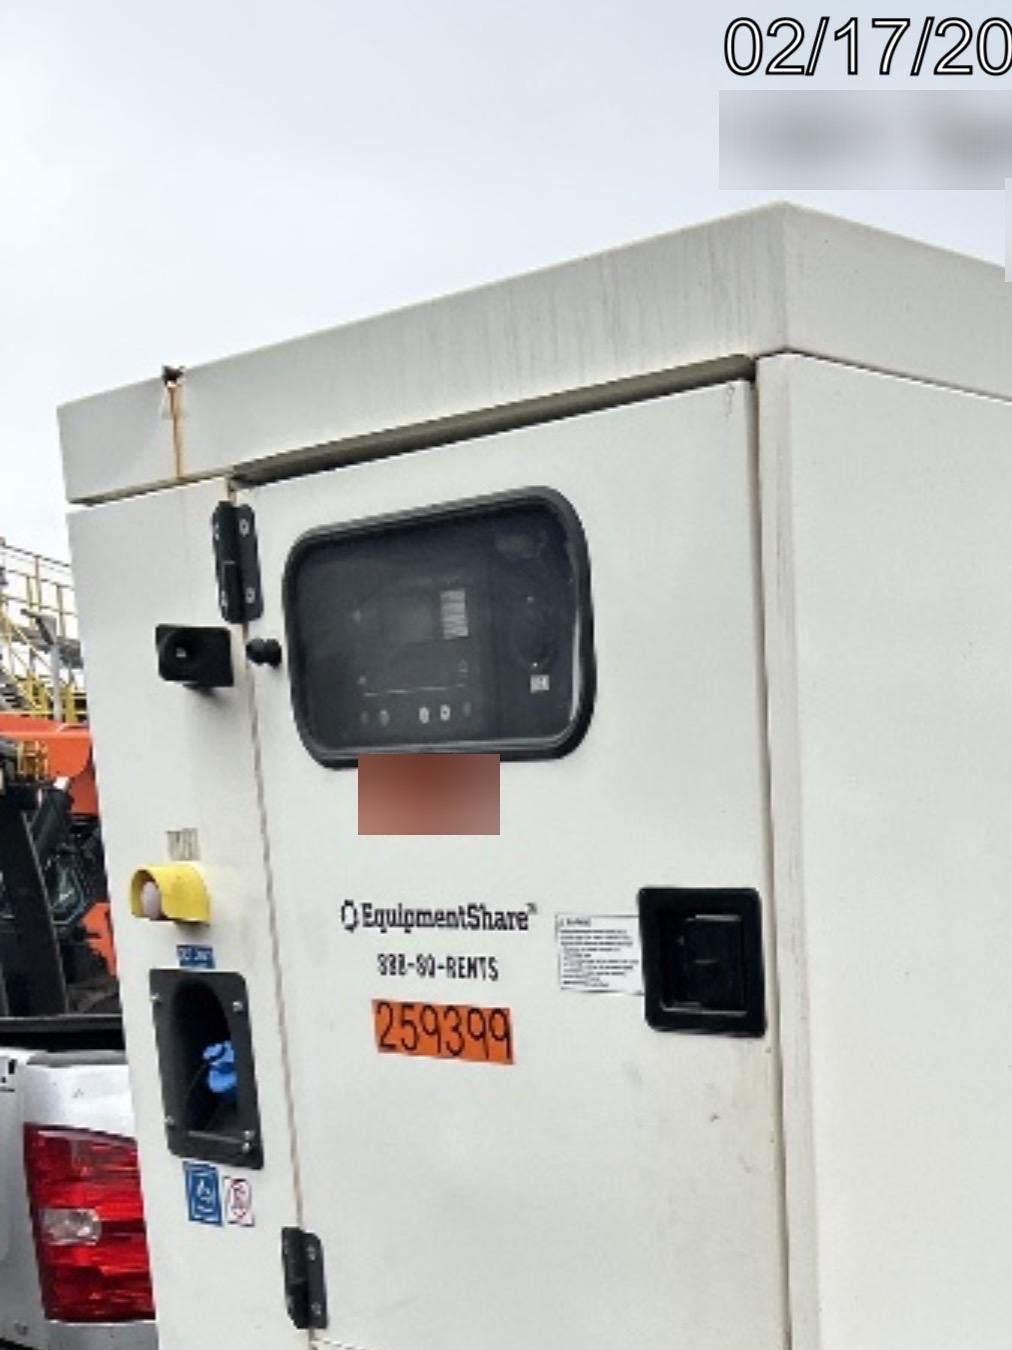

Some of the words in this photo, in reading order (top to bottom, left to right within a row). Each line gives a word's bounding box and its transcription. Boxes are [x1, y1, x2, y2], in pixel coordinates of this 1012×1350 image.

[360, 902, 529, 934] EquipmentShare
[377, 952, 499, 982] 888-80-RENTS
[375, 1001, 512, 1060] 259399
